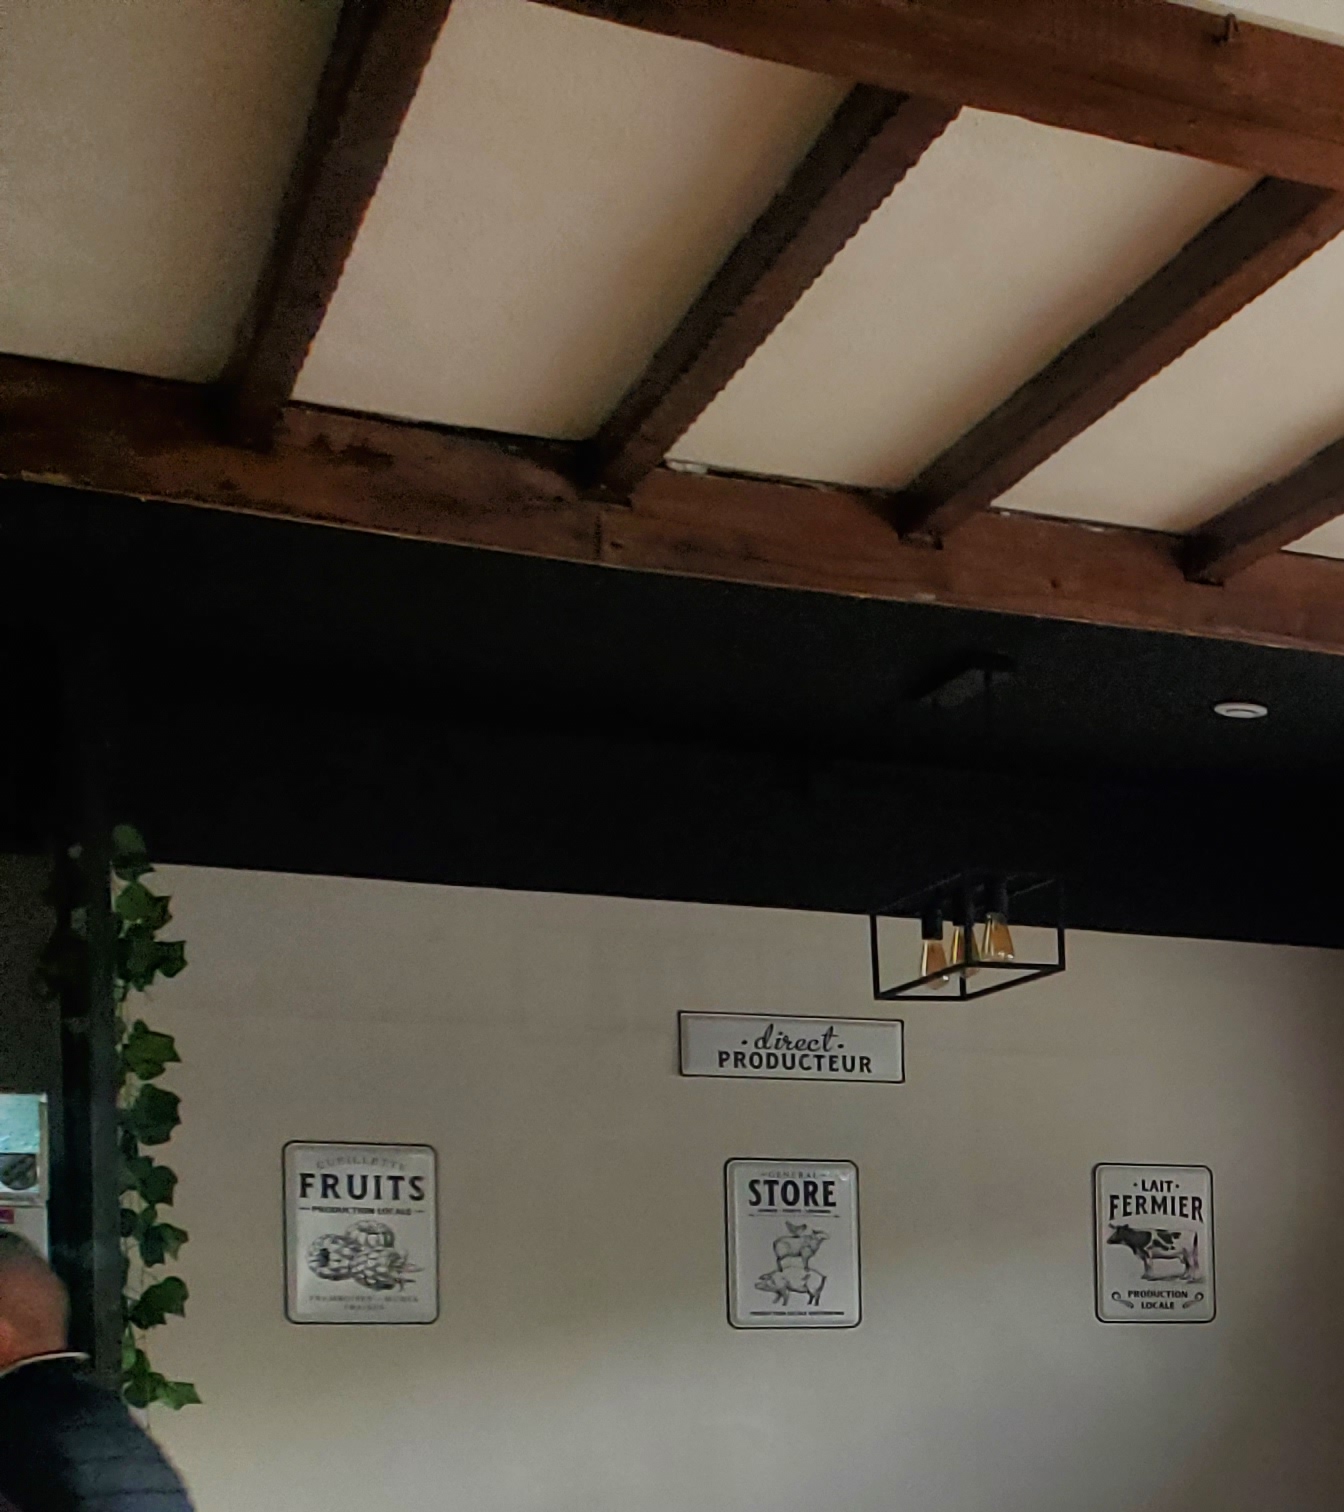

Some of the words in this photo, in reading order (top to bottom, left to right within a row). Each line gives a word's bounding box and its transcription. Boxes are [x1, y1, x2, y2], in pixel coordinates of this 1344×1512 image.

[754, 1025, 837, 1053] direct
[718, 1051, 873, 1075] PRODUCTEUR
[299, 1173, 425, 1202] FRUITS
[748, 1179, 837, 1207] STORE
[1141, 1179, 1174, 1193] LAIT
[1109, 1194, 1204, 1223] FERMIER
[1127, 1289, 1188, 1299] PRODUCTION
[1141, 1301, 1175, 1310] LOCALE
